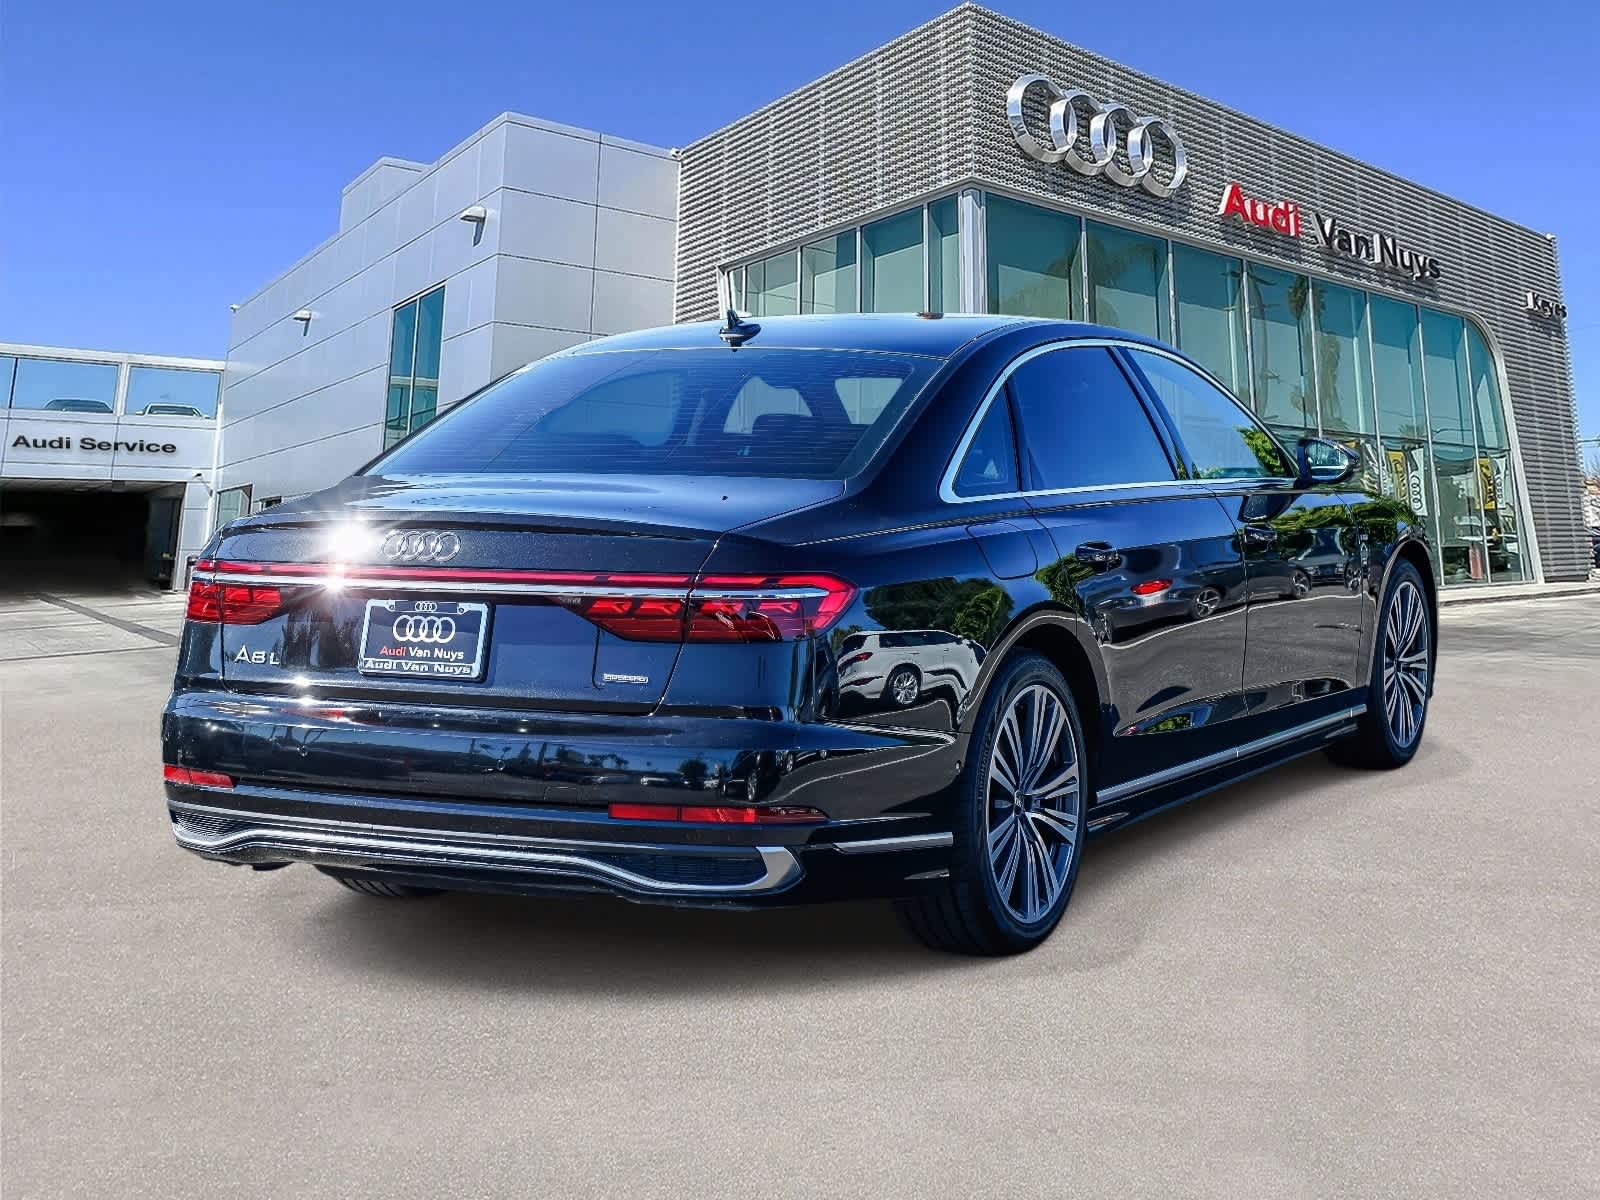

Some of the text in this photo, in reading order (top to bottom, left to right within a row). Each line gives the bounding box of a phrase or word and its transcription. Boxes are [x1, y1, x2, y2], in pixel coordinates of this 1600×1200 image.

[1217, 181, 1441, 281] Audi Van Nuys
[12, 434, 177, 454] Audi Service
[234, 644, 266, 665] A8
[380, 645, 465, 661] Audi Van Nuys
[364, 659, 471, 675] Audi Van Nuys
